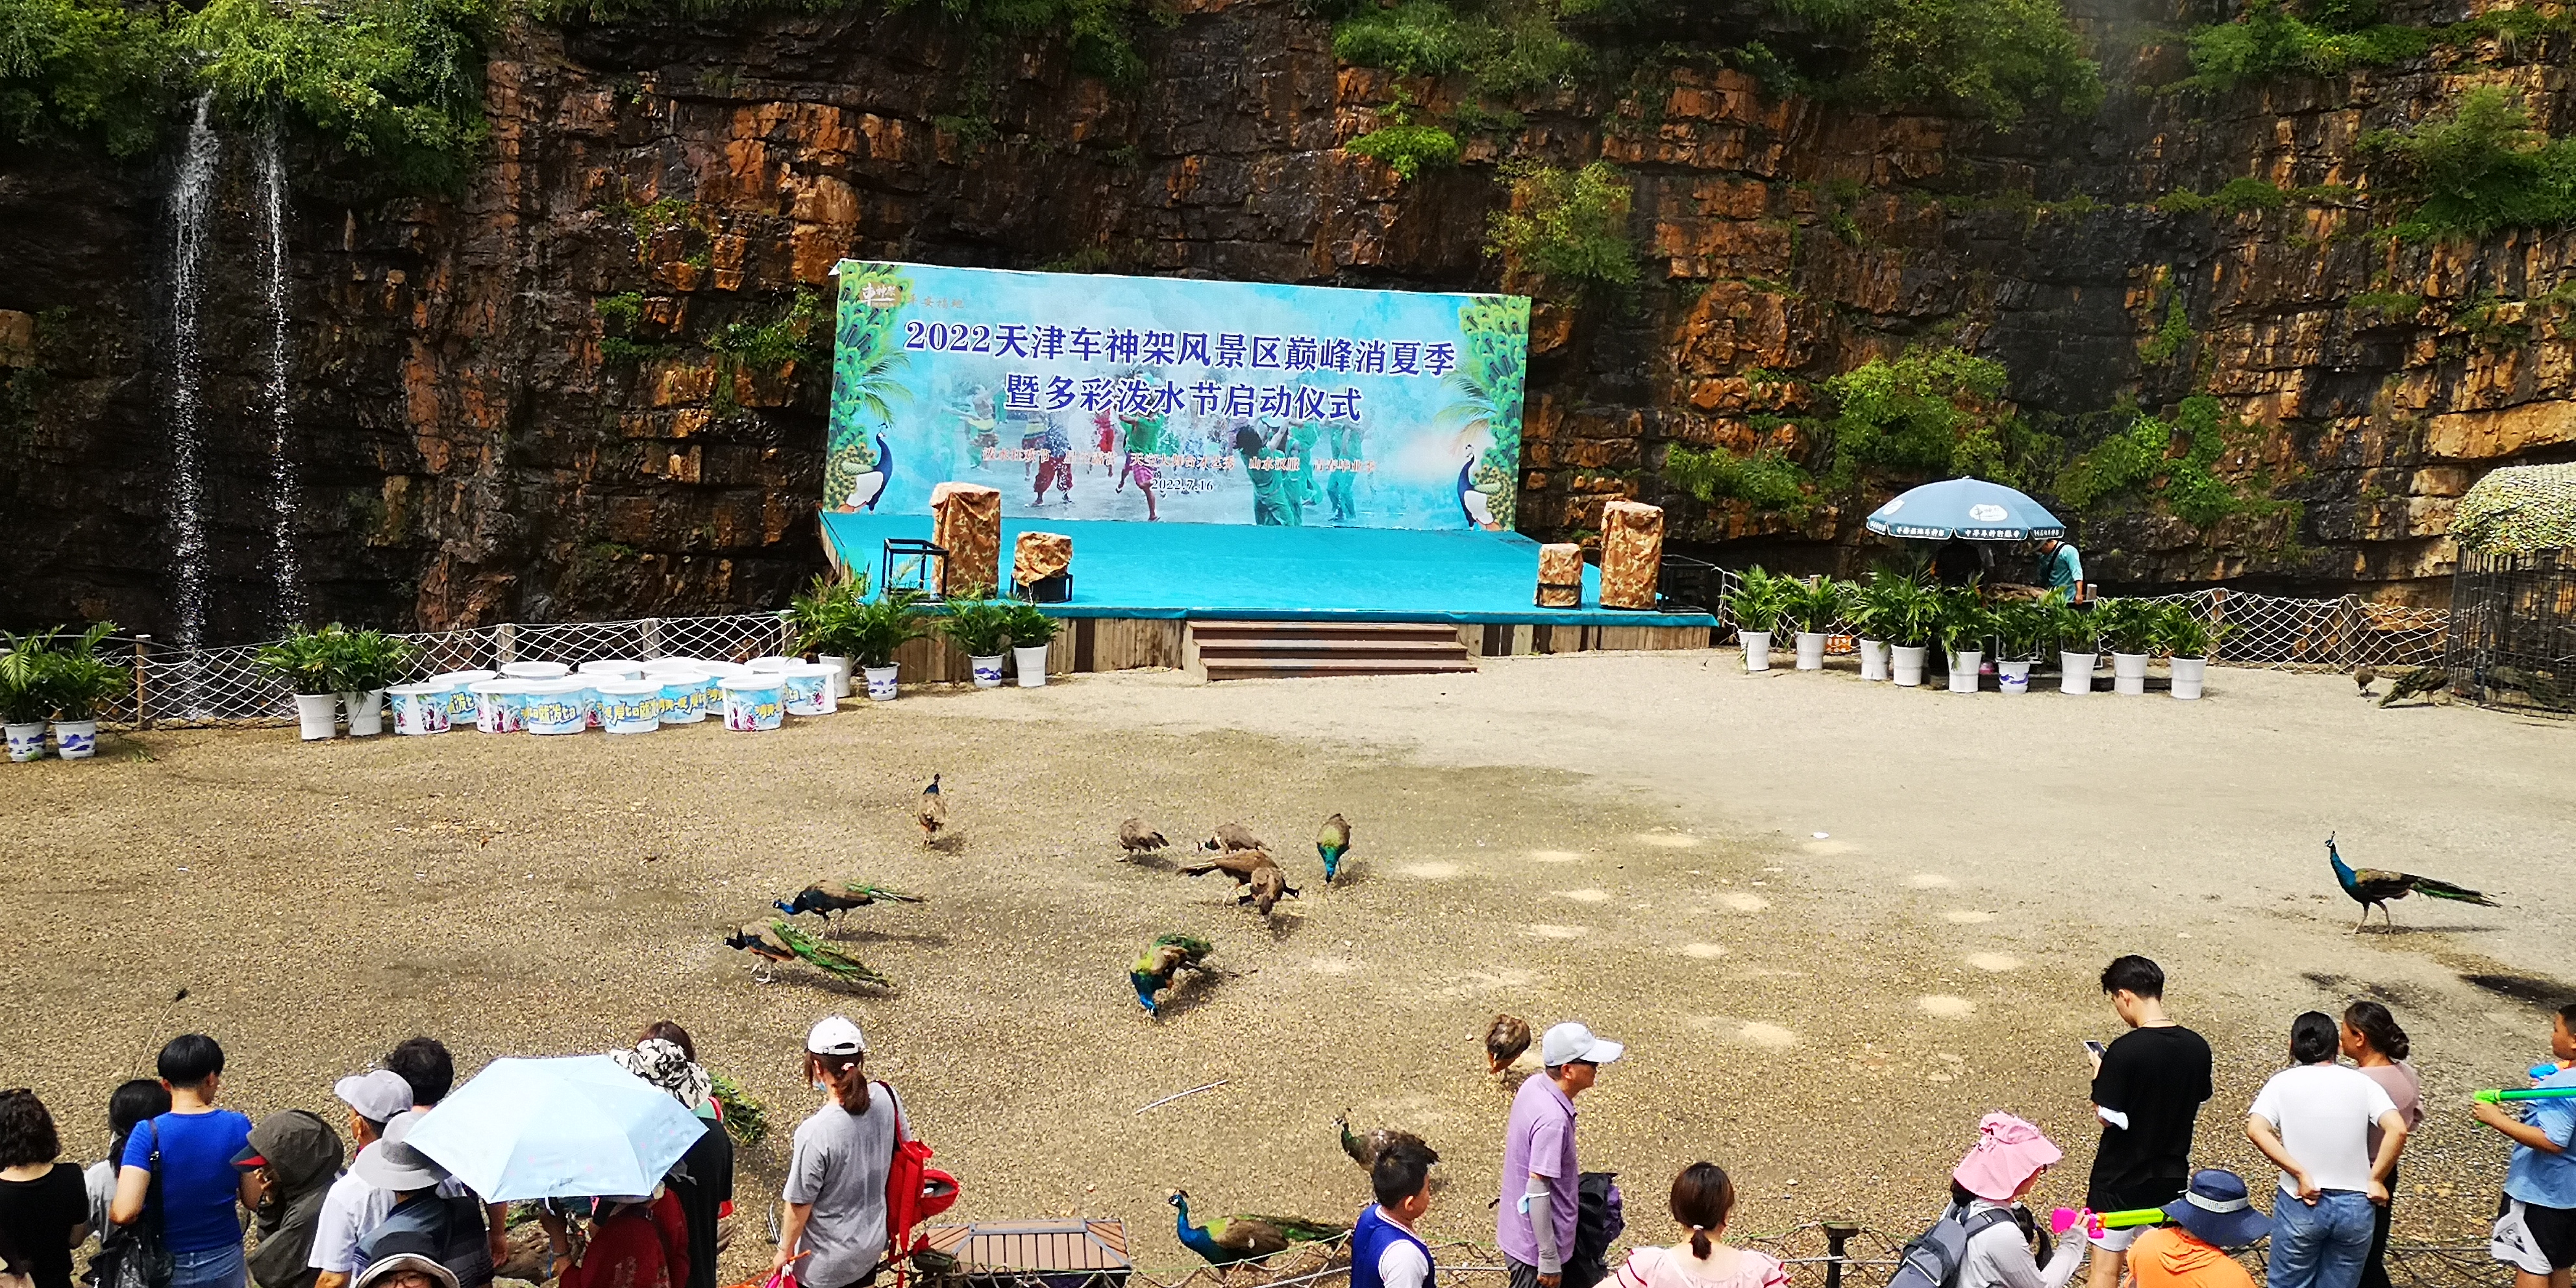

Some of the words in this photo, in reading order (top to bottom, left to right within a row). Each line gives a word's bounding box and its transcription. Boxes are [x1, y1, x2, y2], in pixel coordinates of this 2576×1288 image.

[905, 322, 1456, 376] 2022天津车神架风景区巅峰消夏季
[1005, 373, 1363, 421] 暨多彩泼水节启动仪式
[1151, 478, 1214, 491] 2022.7.16
